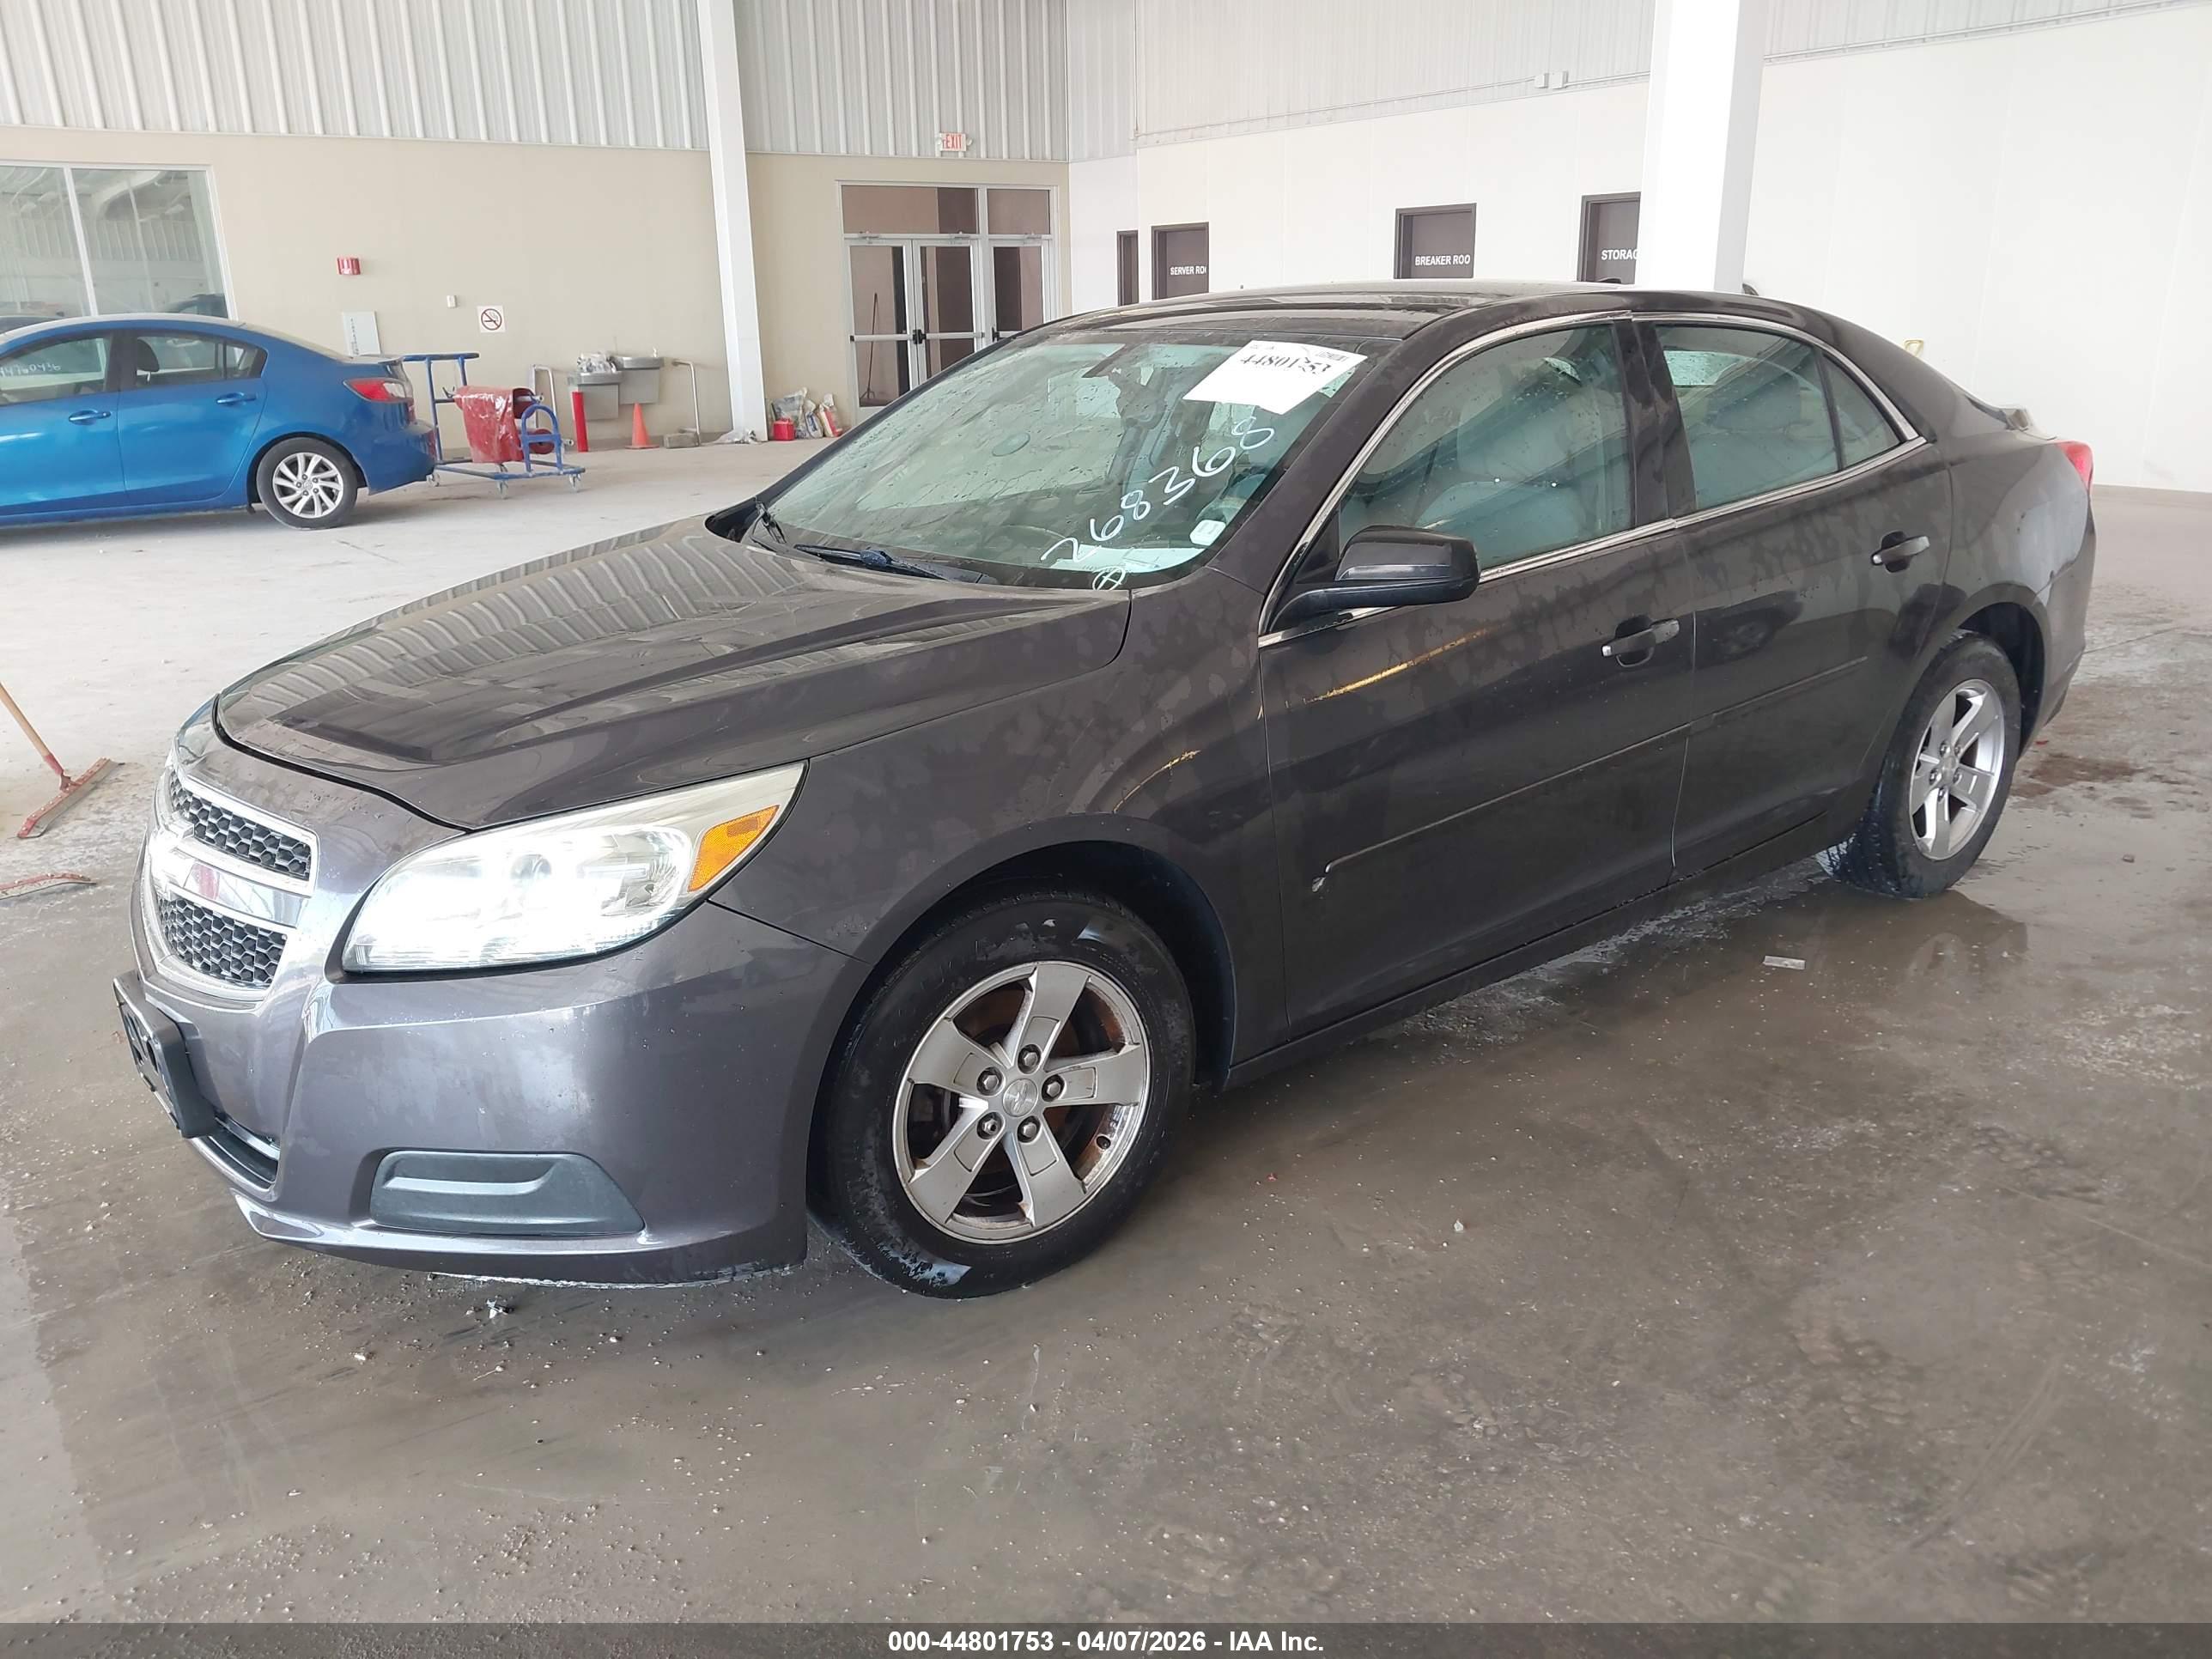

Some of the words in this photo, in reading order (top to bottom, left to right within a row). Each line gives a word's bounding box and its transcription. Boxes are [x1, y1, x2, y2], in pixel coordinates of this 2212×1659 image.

[946, 134, 962, 149] EXIT
[1414, 255, 1451, 265] BREAKER
[1452, 254, 1470, 264] ROO
[1170, 266, 1194, 275] SERVER
[1040, 416, 1275, 563] 268368
